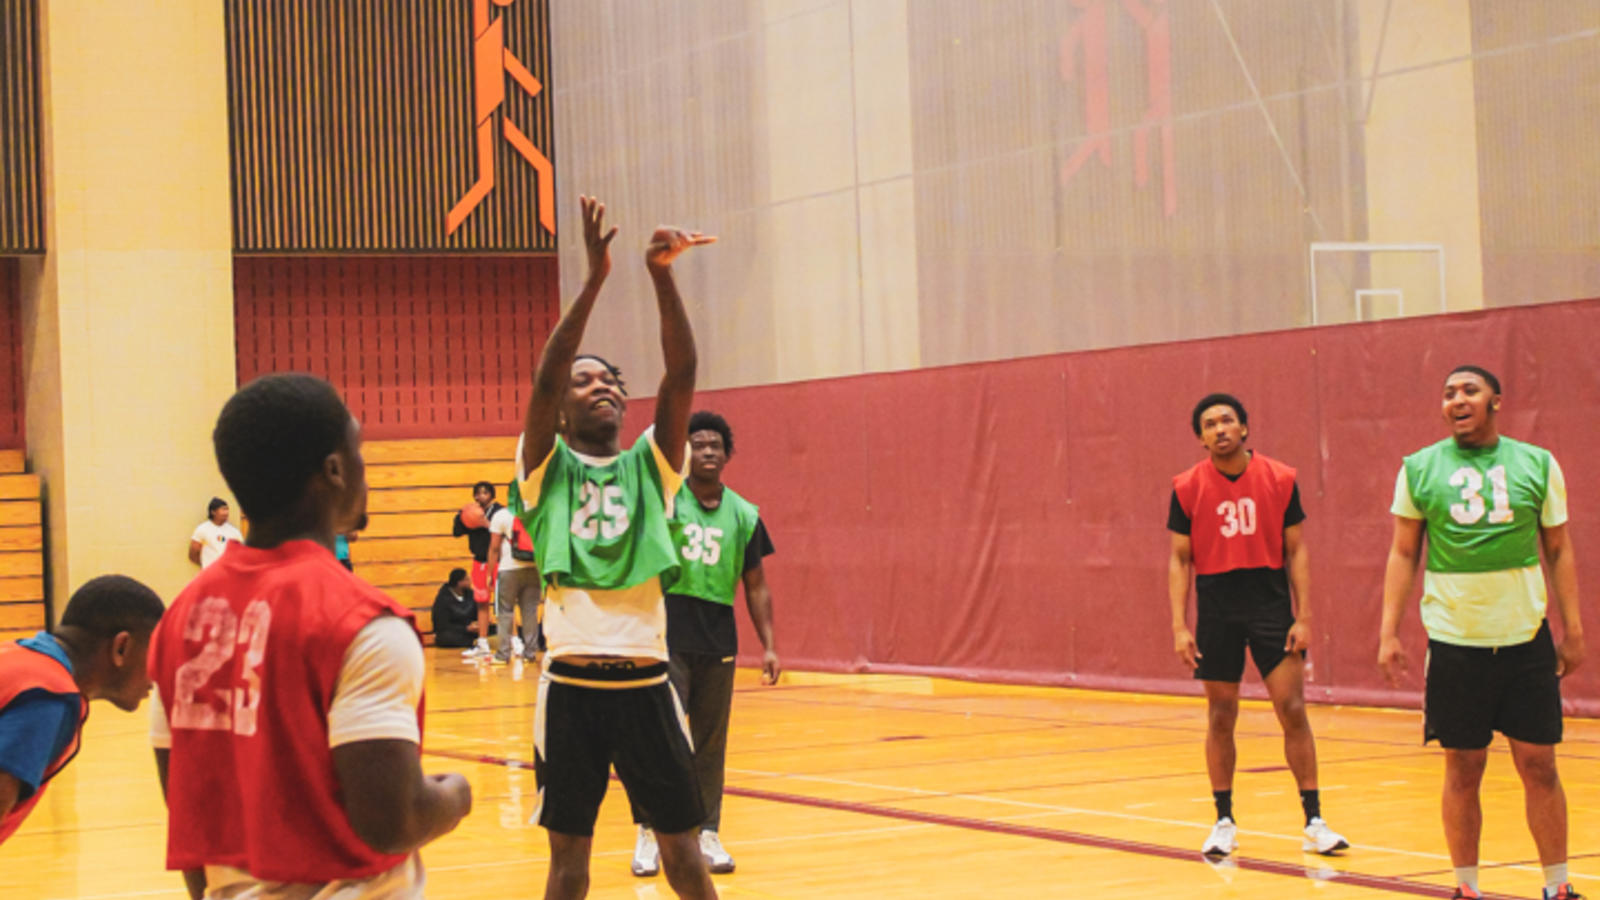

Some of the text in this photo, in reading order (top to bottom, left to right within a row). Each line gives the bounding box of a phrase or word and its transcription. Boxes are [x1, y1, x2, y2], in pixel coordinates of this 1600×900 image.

[570, 480, 630, 540] 25
[1216, 497, 1257, 538] 30
[1449, 464, 1514, 524] 31
[681, 523, 723, 565] 35
[171, 596, 271, 737] 23
